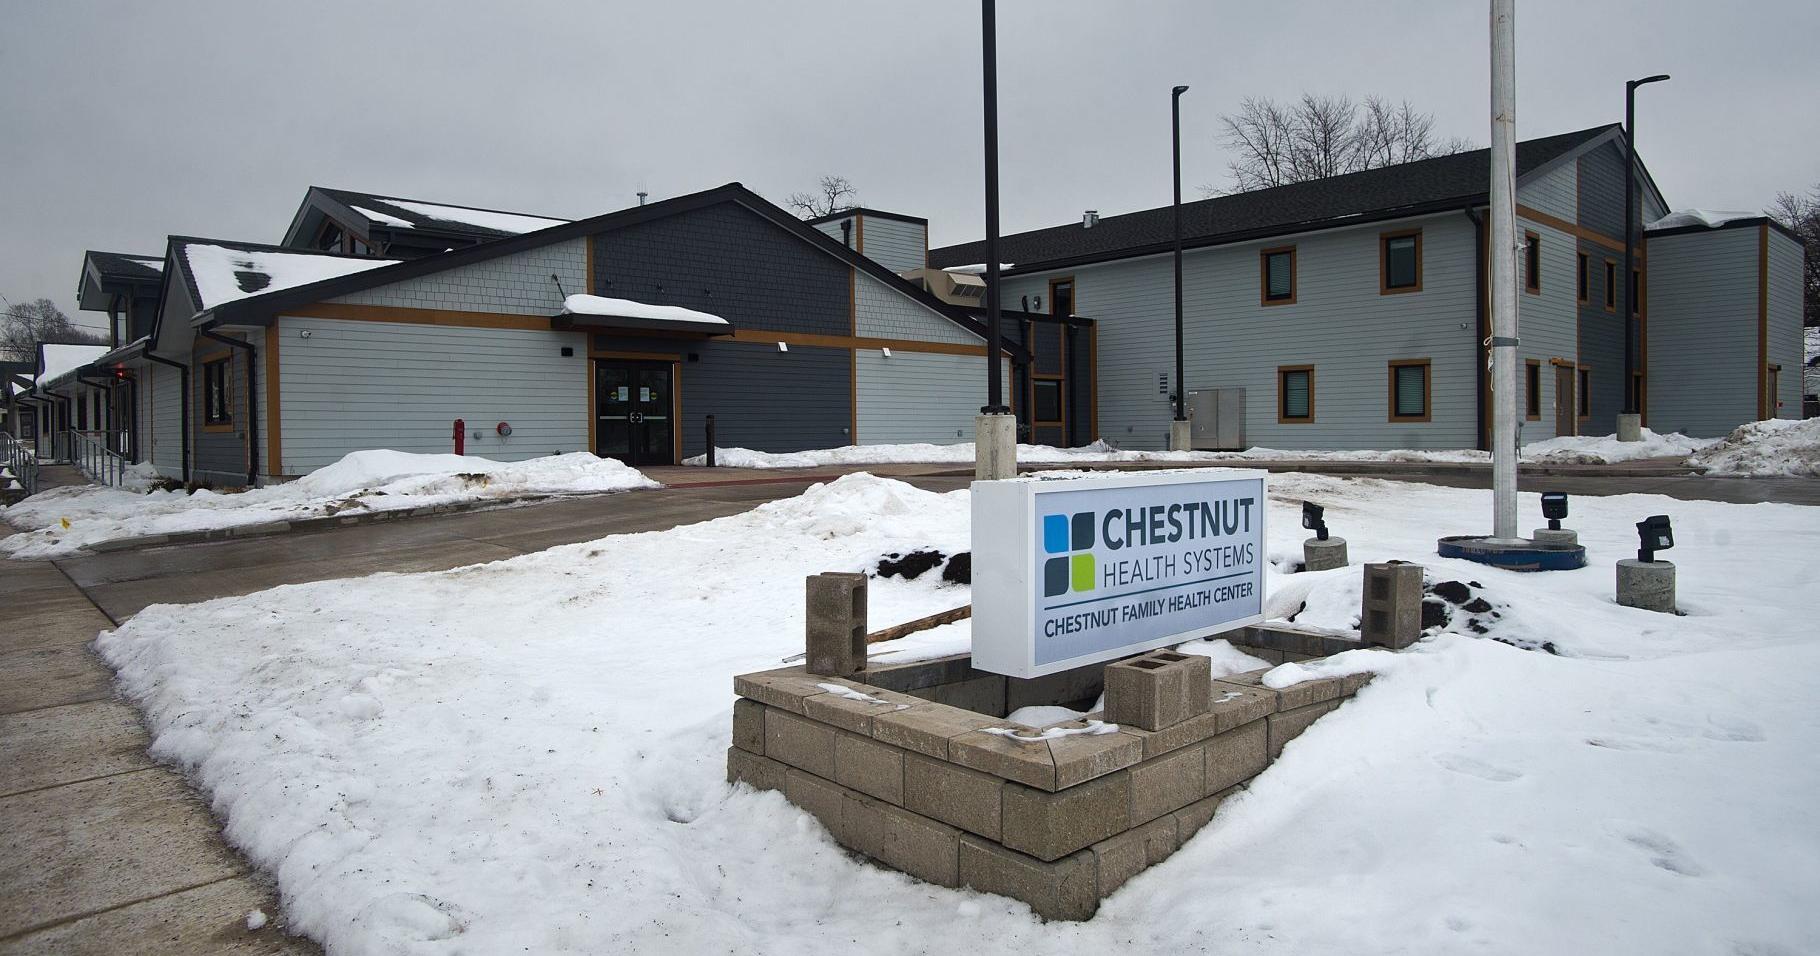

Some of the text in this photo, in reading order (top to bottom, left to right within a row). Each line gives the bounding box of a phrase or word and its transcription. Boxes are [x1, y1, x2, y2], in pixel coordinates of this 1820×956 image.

[1102, 498, 1254, 551] CHESTNUT
[1104, 543, 1254, 588] HEALTH SYSTEMS
[1044, 582, 1253, 638] CHESTNUT FAMILY HEALTH CENTER
